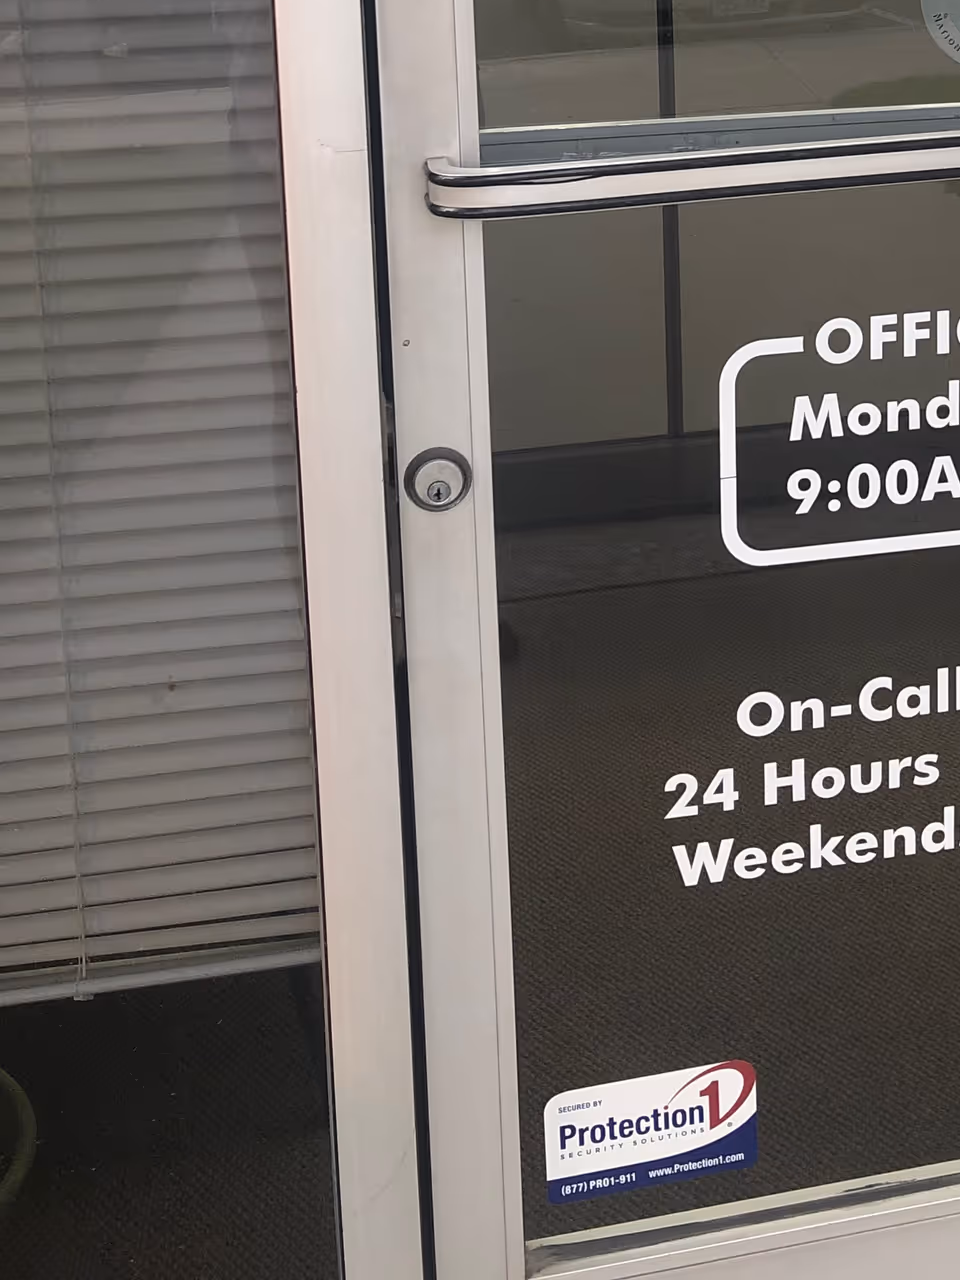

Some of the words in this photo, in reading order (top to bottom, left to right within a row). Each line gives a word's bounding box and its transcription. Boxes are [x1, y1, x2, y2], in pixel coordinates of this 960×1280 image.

[663, 768, 739, 820] 24
[764, 754, 940, 806] Hours
[558, 1101, 591, 1114] SECURED
[593, 1100, 602, 1108] BY
[560, 1143, 623, 1160] SECURITY
[633, 1127, 705, 1146] SOLUTIONS
[561, 1182, 588, 1197] (877)
[648, 1152, 745, 1179] www.Protection1.com
